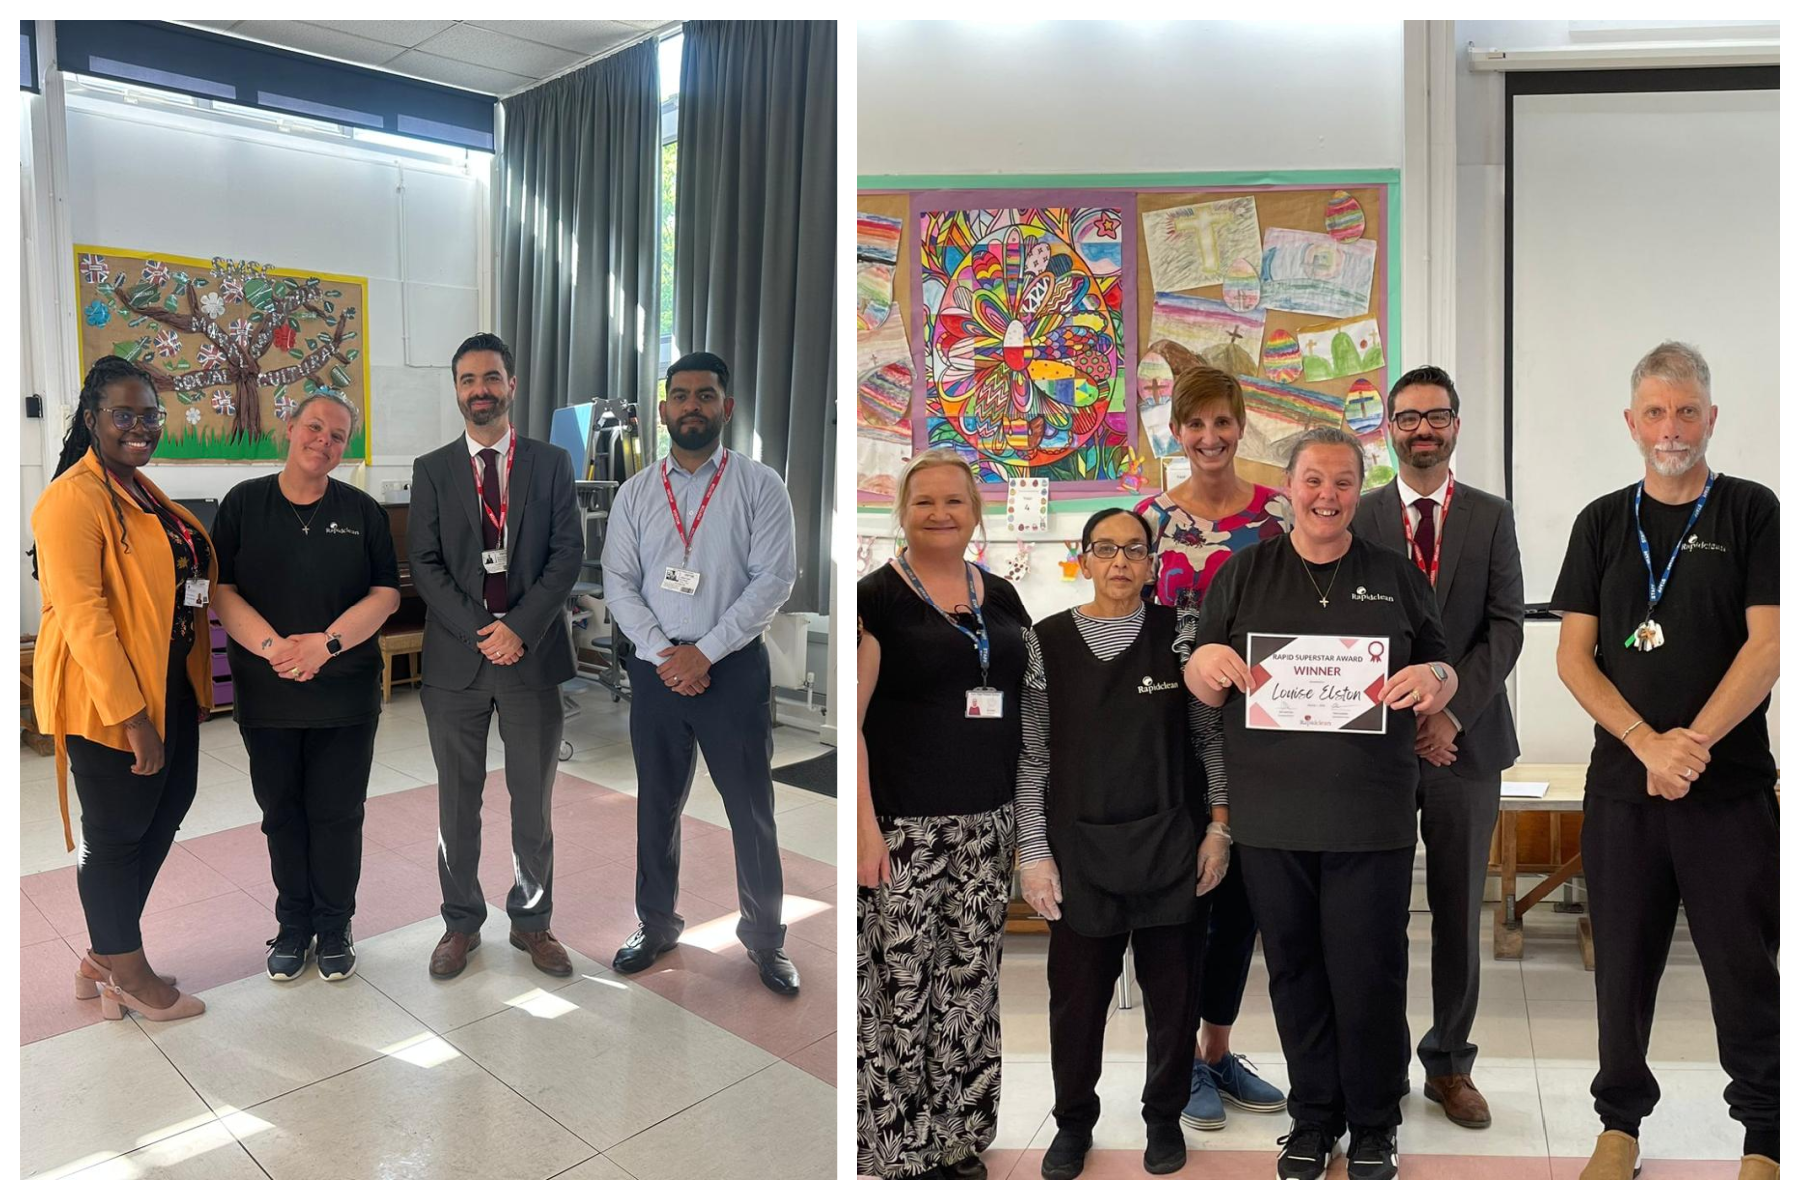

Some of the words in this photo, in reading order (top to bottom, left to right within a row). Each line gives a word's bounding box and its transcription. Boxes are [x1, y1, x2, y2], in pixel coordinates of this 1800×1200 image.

[256, 342, 340, 387] CULTURAL
[173, 369, 231, 391] SOCIAL
[1351, 592, 1395, 602] Rapidclean
[1272, 653, 1294, 661] RAPID
[1295, 654, 1335, 662] SUPERSTAR
[1293, 665, 1341, 676] WINNER
[1137, 681, 1179, 694] Rapidclean
[1271, 683, 1314, 701] Louise
[1319, 684, 1361, 702] Elston
